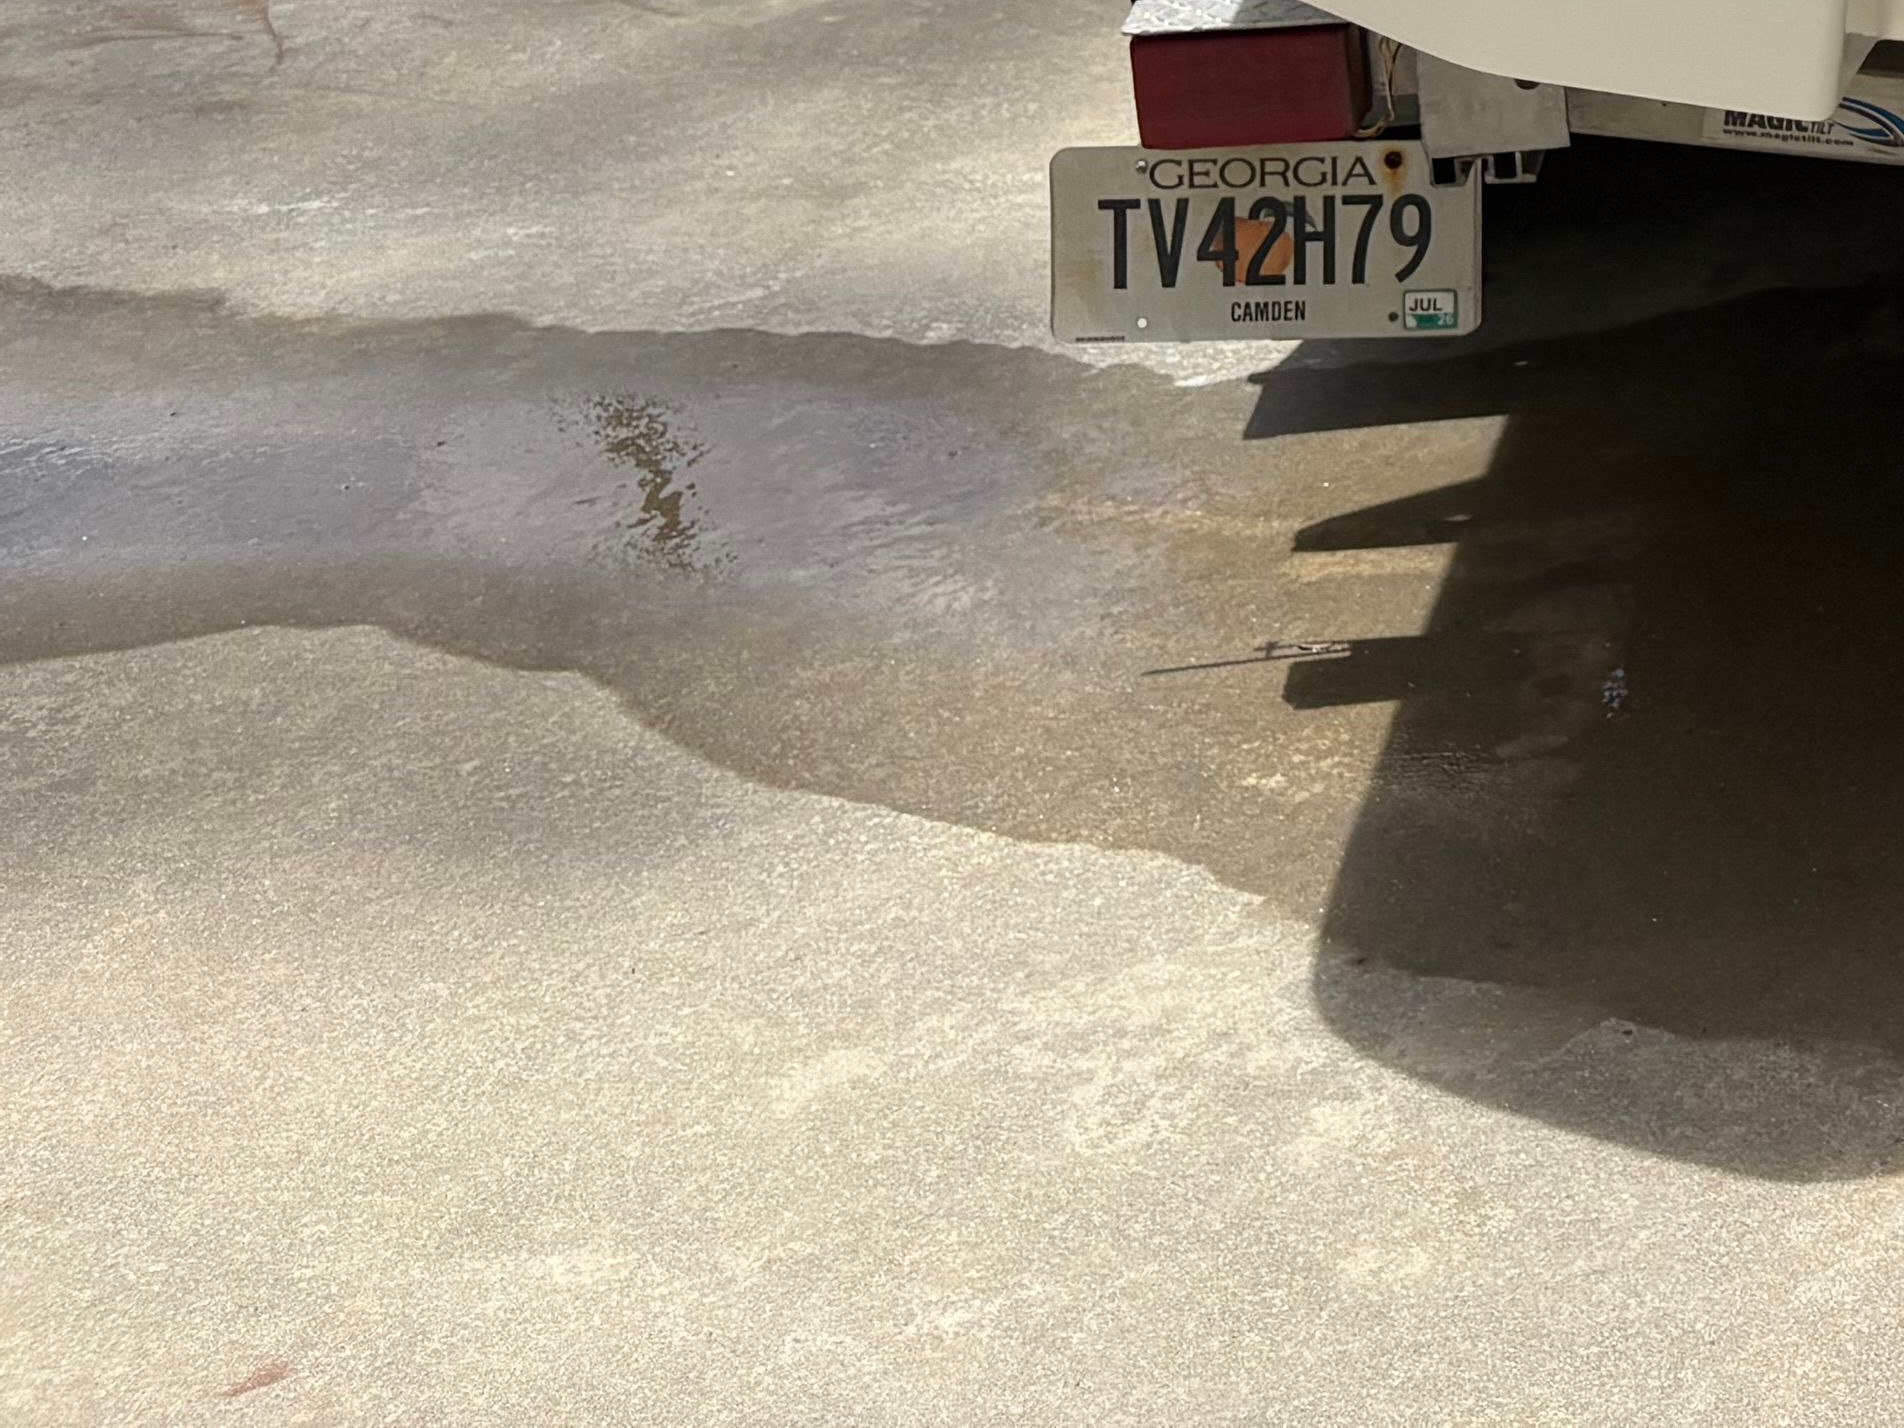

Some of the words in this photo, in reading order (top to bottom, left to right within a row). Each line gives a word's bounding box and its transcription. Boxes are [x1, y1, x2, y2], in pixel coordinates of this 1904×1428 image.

[1724, 109, 1809, 133] MAGIC
[1722, 128, 1854, 146] www.magictilt.com
[1149, 156, 1377, 190] GEORGIA
[1097, 193, 1433, 290] TV42H79
[1230, 299, 1306, 323] CAMDEN
[1409, 297, 1443, 312] JUL
